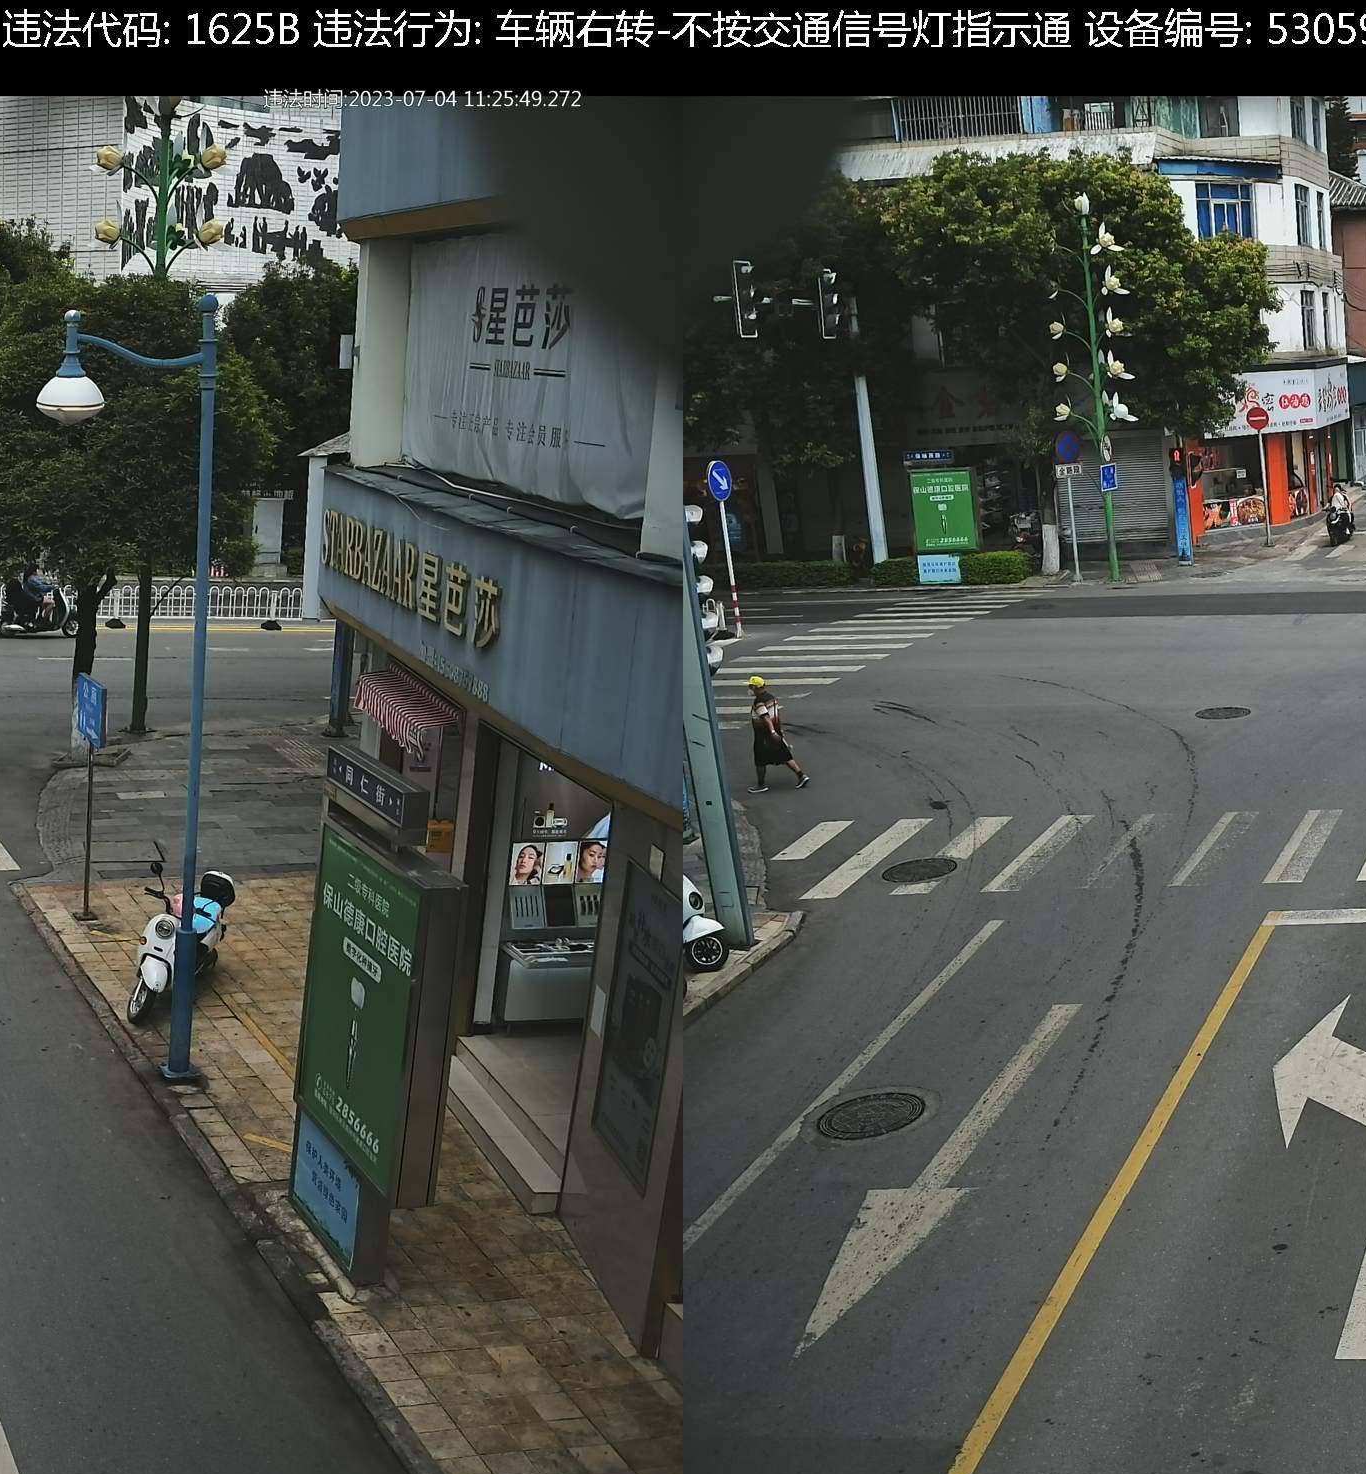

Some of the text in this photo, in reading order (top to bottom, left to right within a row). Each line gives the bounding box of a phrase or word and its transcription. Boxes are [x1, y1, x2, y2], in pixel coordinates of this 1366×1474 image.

[485, 283, 574, 350] 星芭莎
[321, 509, 501, 649] STARBAZAAR 星芭莎
[345, 764, 386, 807] 同仁街
[323, 882, 413, 977] 保山德康口腔医院
[335, 1096, 380, 1155] 2856666
